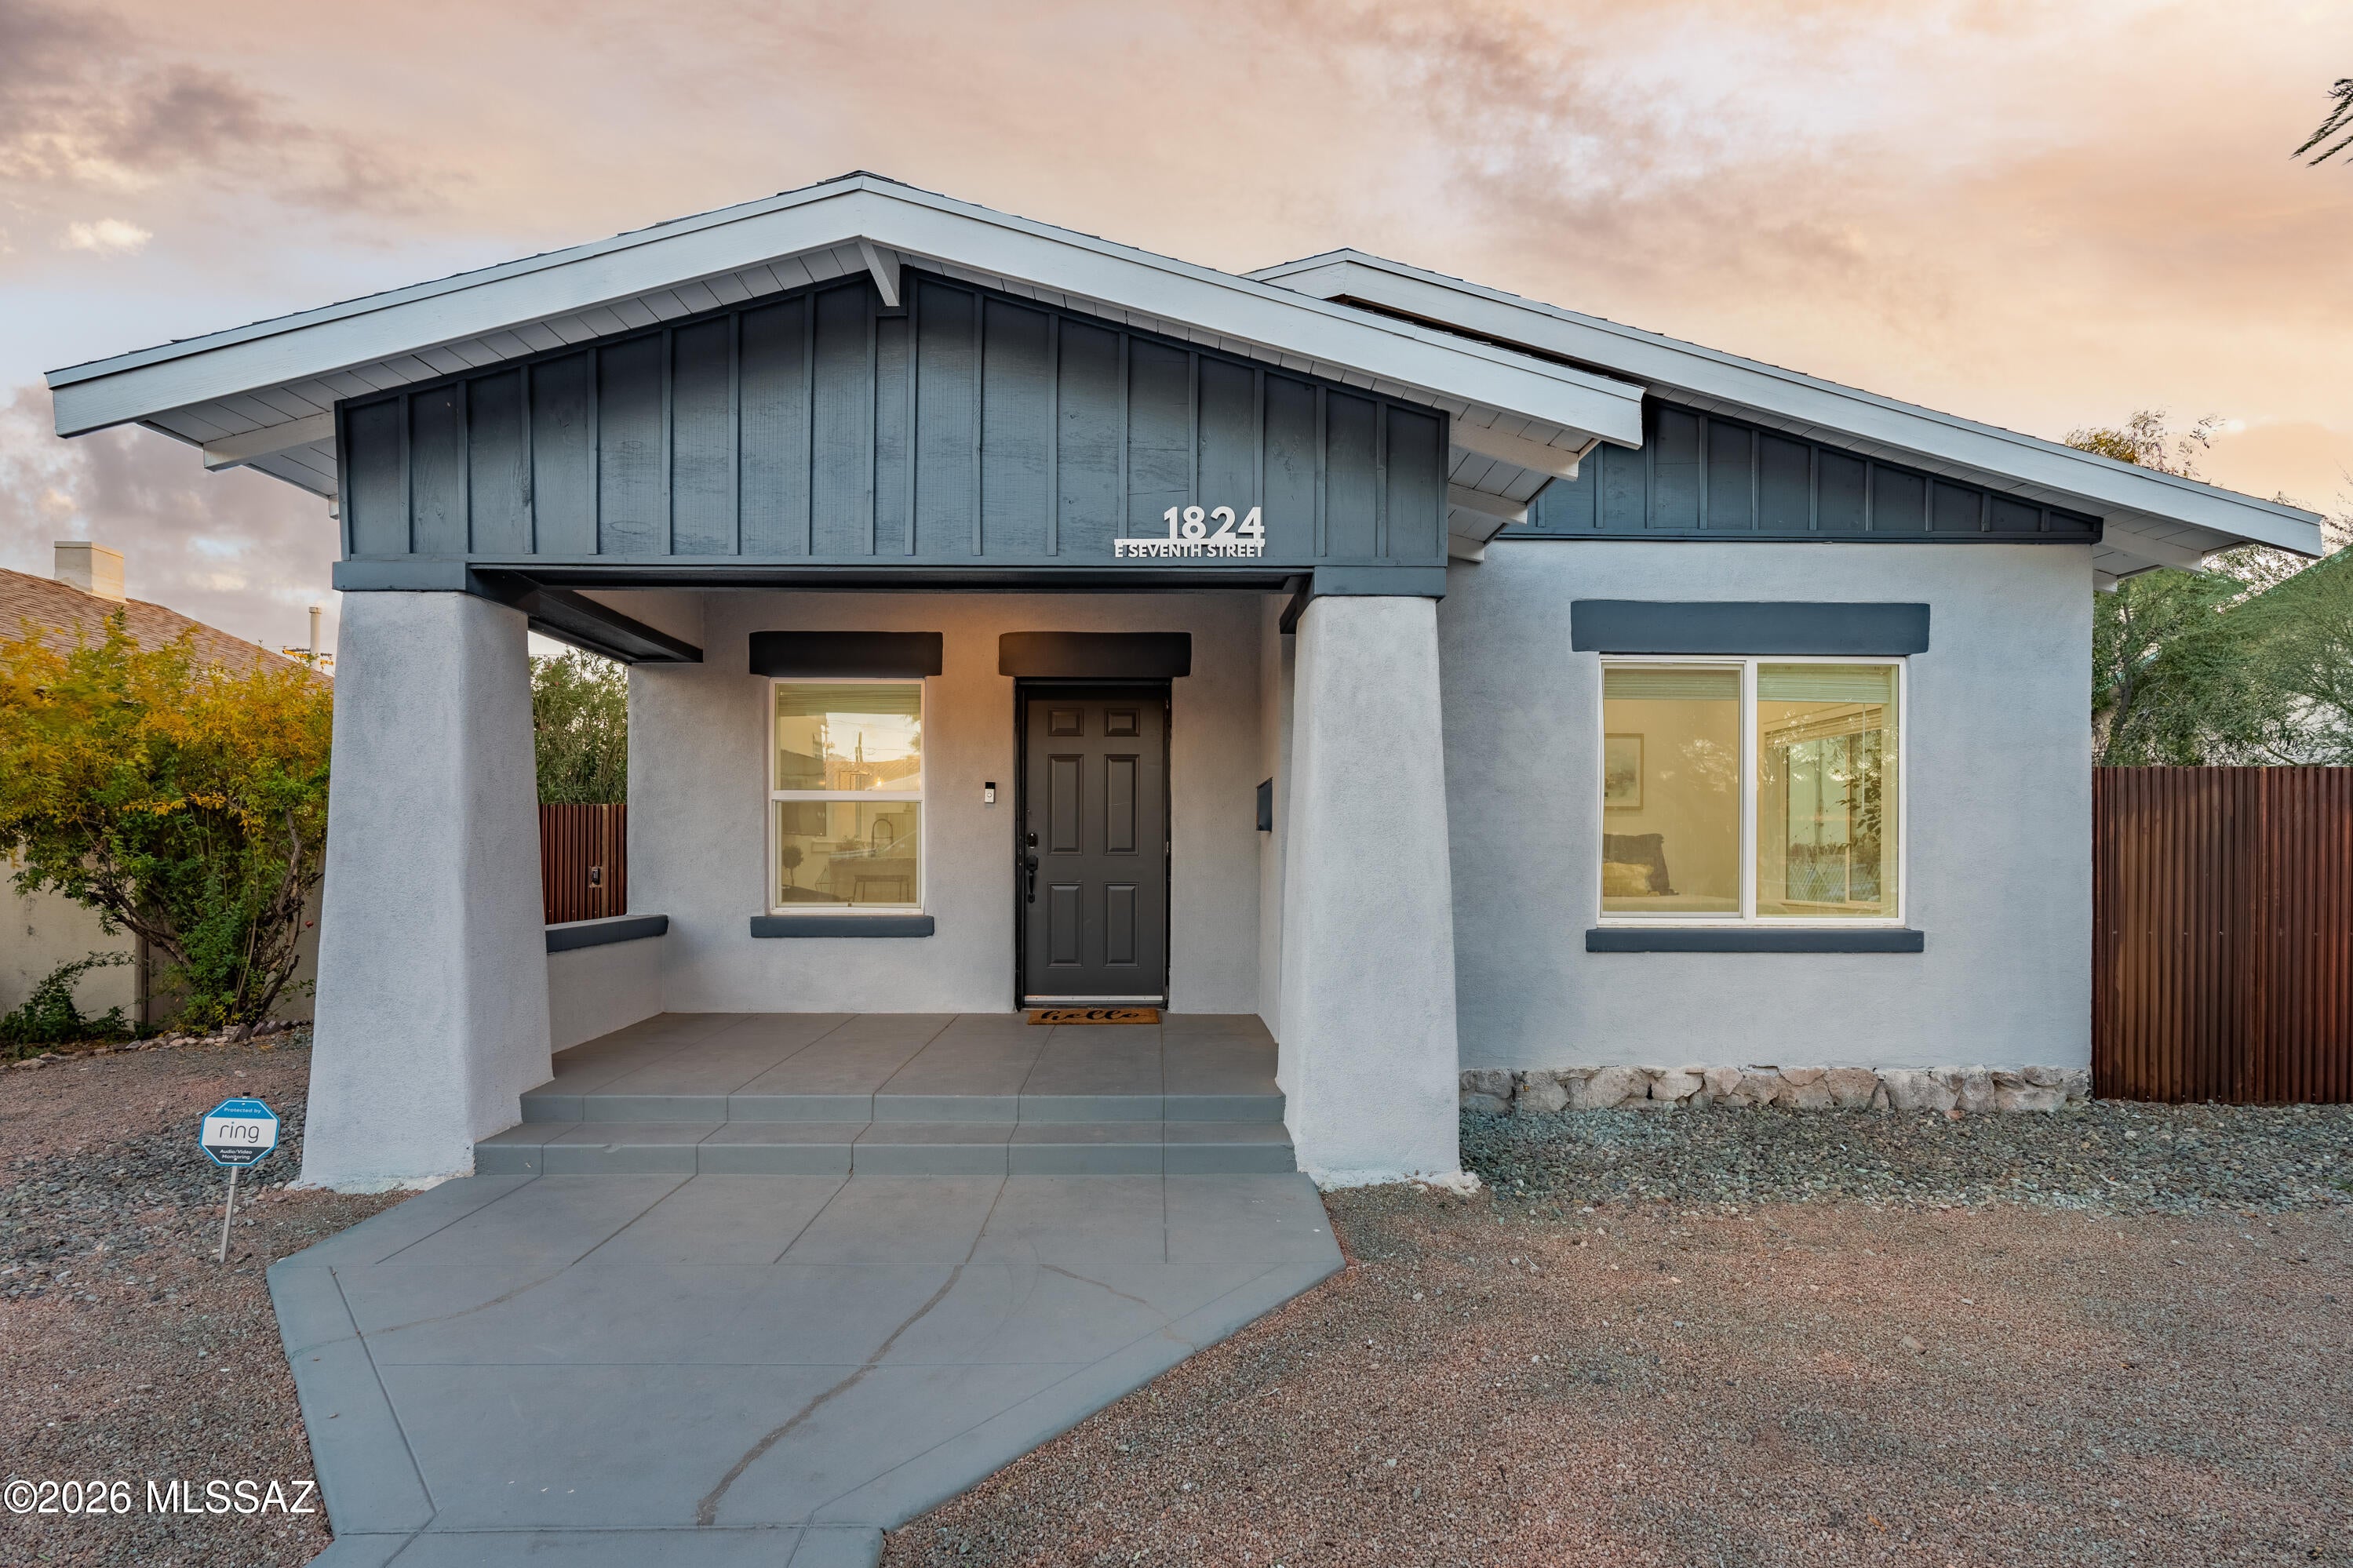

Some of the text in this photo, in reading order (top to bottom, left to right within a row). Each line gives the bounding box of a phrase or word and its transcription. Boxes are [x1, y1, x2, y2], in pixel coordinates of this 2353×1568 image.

[1164, 506, 1265, 541] 1824
[1115, 544, 1264, 558] E SEVENTH STREET
[1041, 1010, 1141, 1020] hello
[220, 1121, 260, 1144] ring
